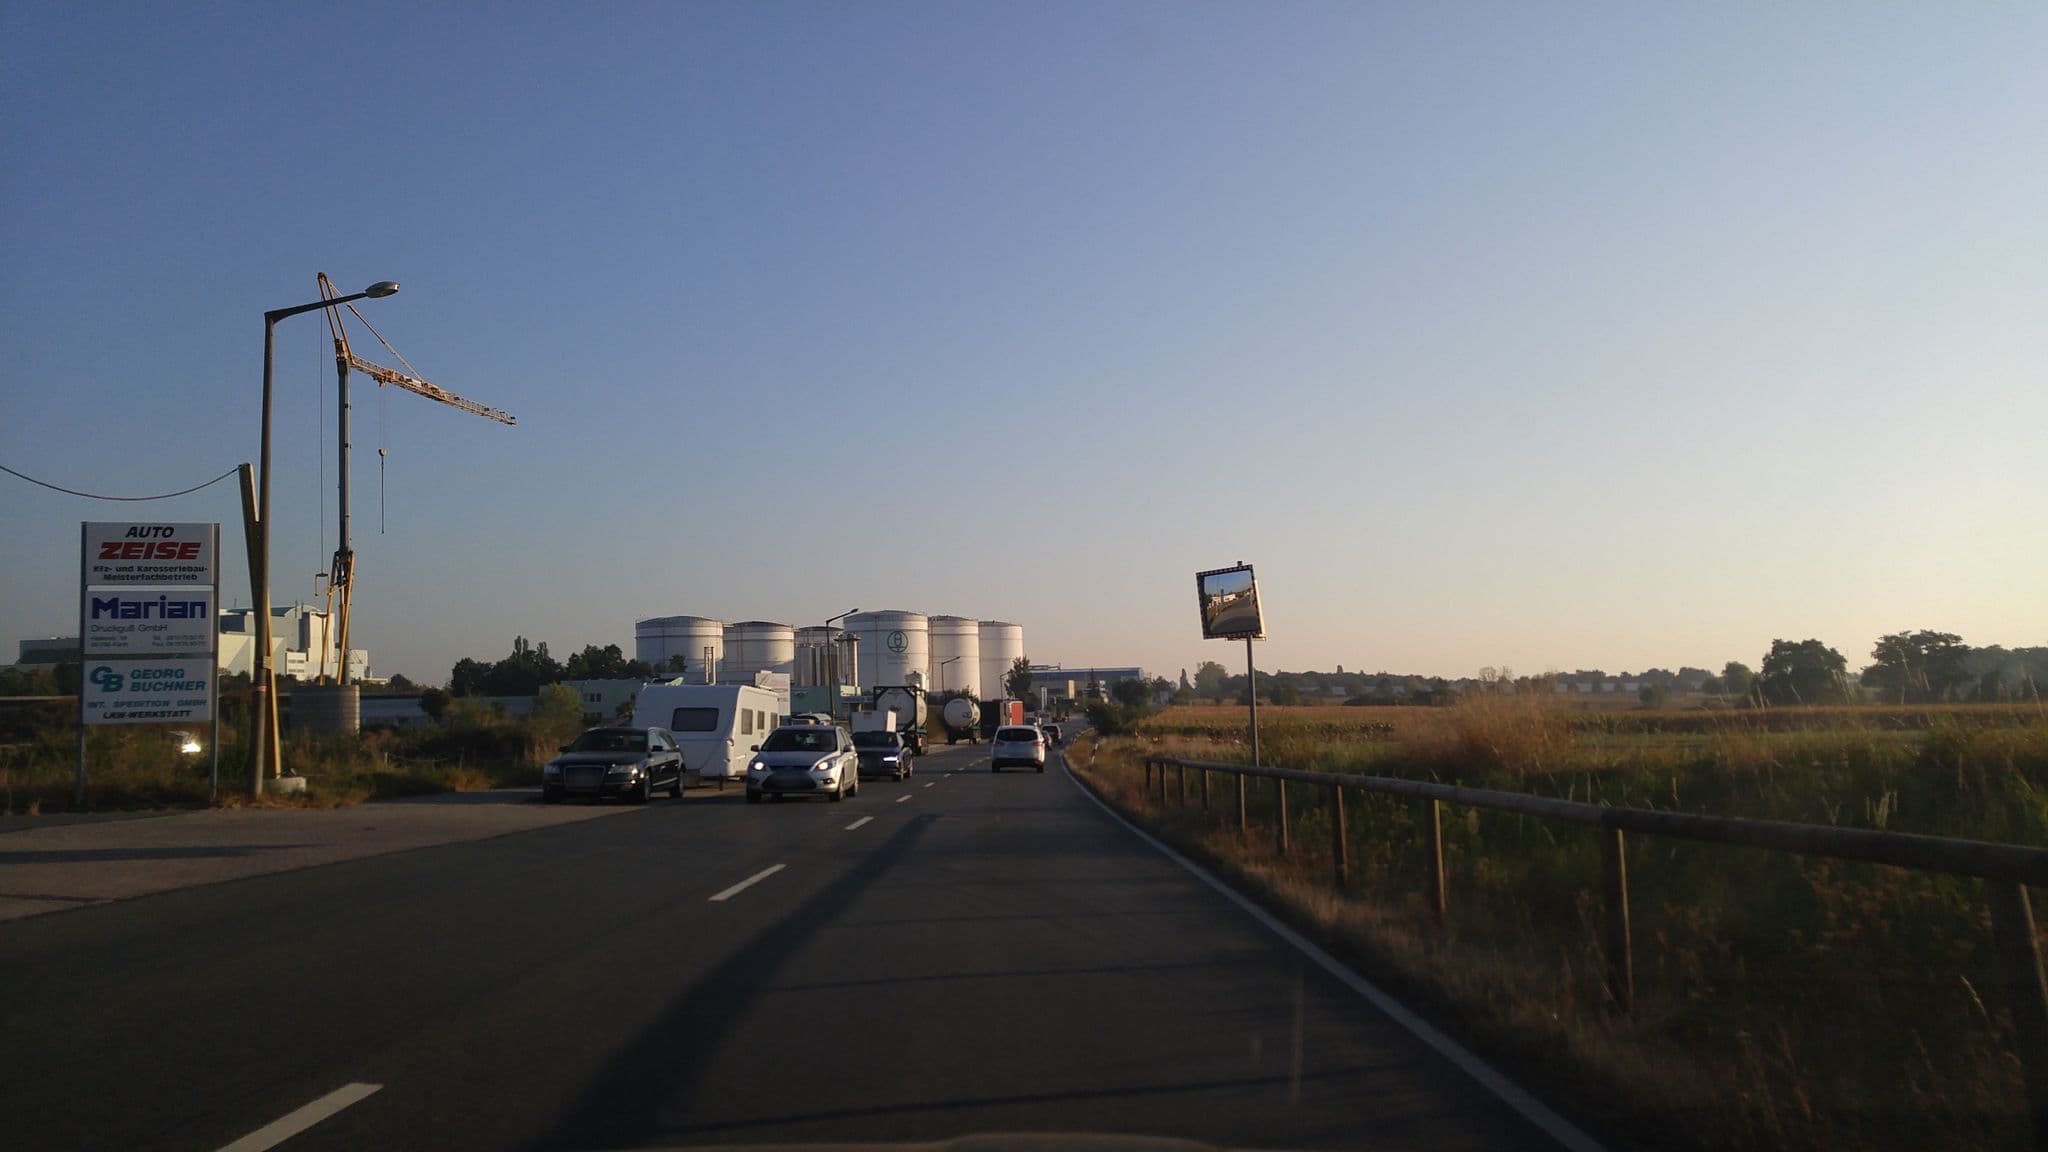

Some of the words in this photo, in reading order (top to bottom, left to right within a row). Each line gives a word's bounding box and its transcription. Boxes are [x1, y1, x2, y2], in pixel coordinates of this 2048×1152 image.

[125, 526, 175, 538] AUTO
[98, 542, 202, 560] ZEISE
[92, 595, 207, 619] Marian
[138, 624, 168, 632] GmbH
[130, 669, 185, 680] GEORG
[129, 681, 207, 692] BUCHNER
[112, 700, 170, 708] SPEDITION
[176, 699, 207, 707] GMBH
[103, 710, 193, 719] LKW-WERKSTATT
